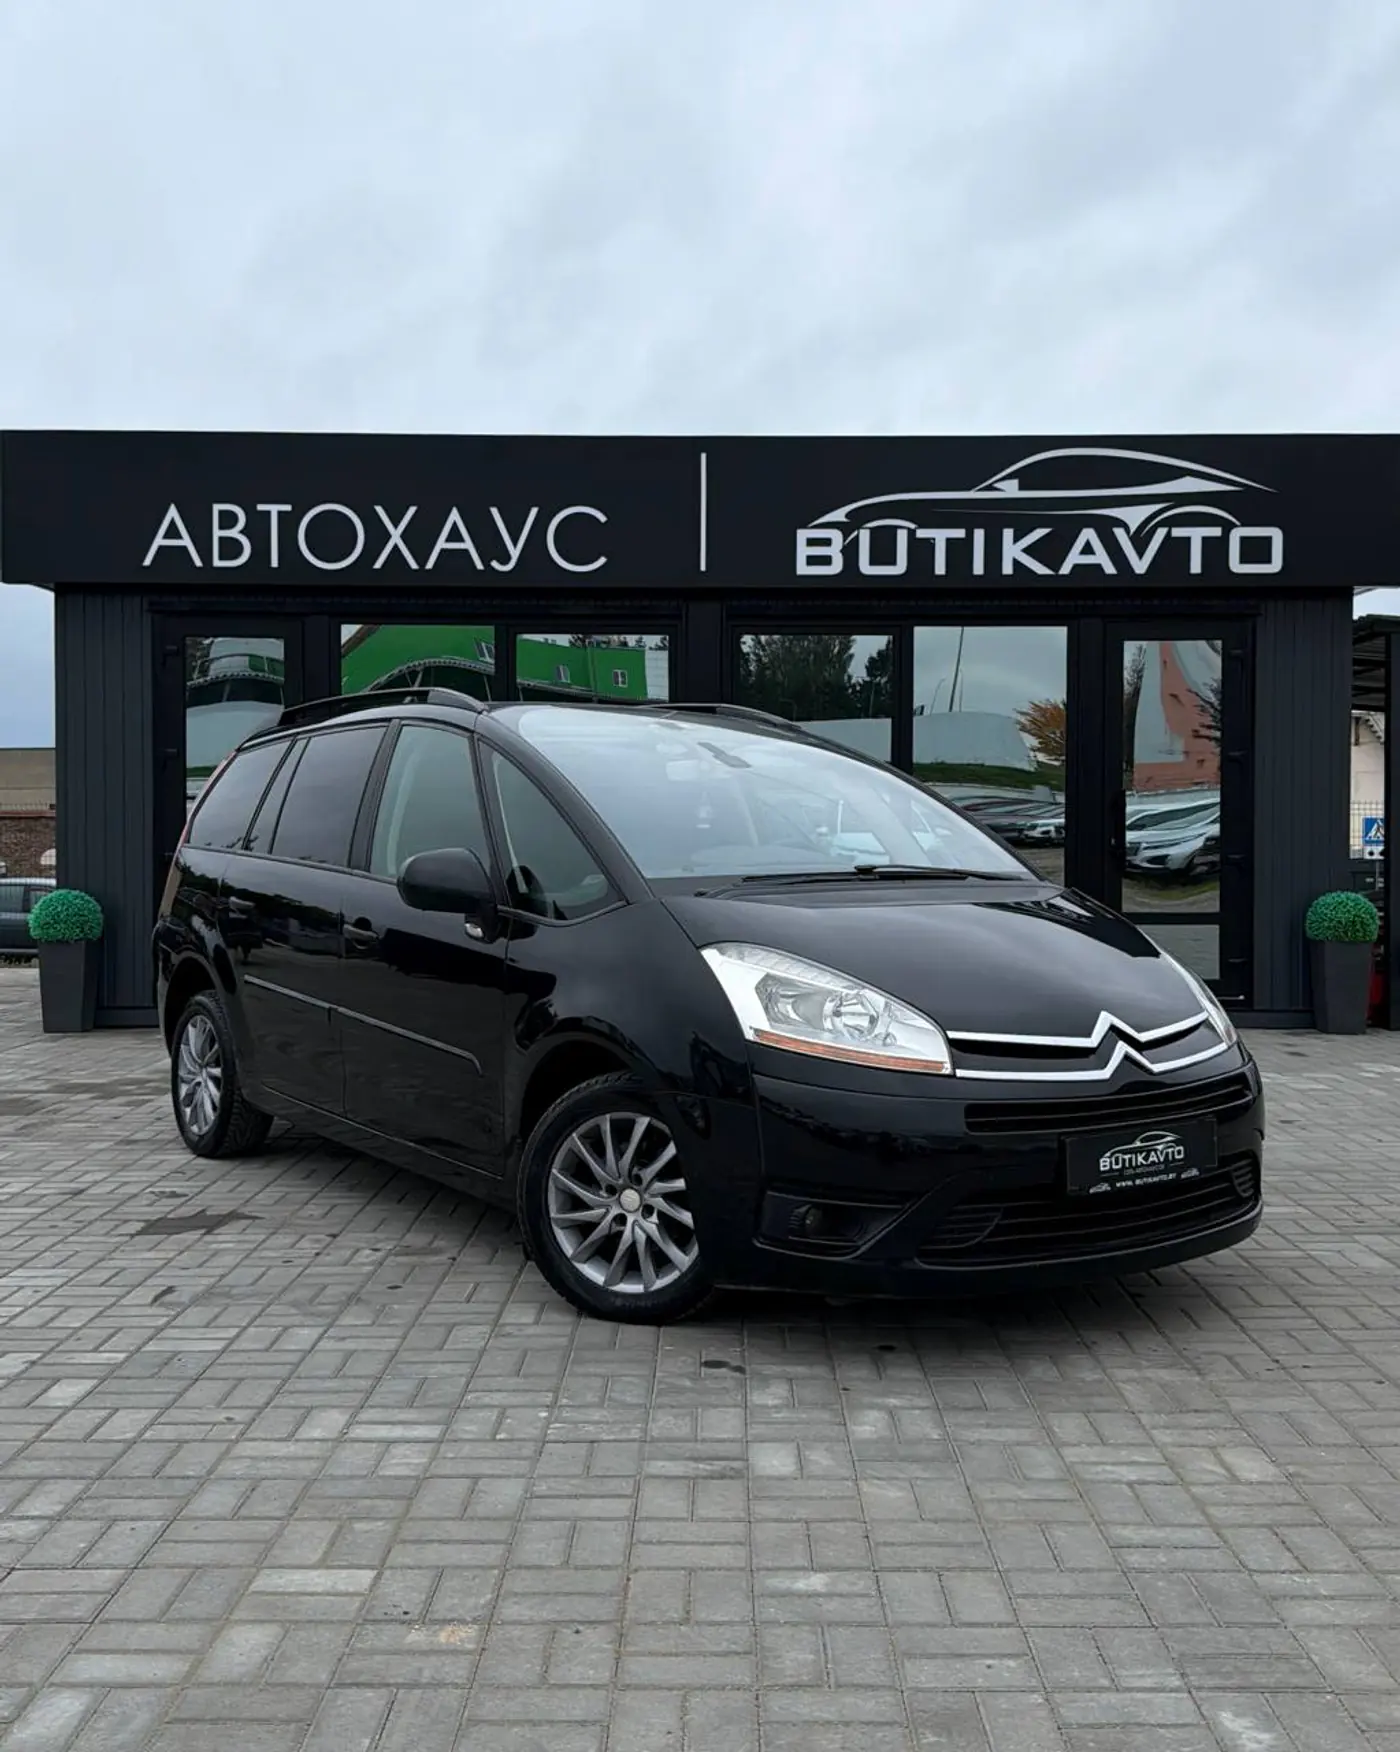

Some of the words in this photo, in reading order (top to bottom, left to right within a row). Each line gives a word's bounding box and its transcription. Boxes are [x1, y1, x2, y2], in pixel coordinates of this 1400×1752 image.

[142, 502, 609, 573] АВТОХАУС
[795, 526, 1284, 577] BUTIKAVTO
[1099, 1145, 1185, 1172] BUTIKAVTO
